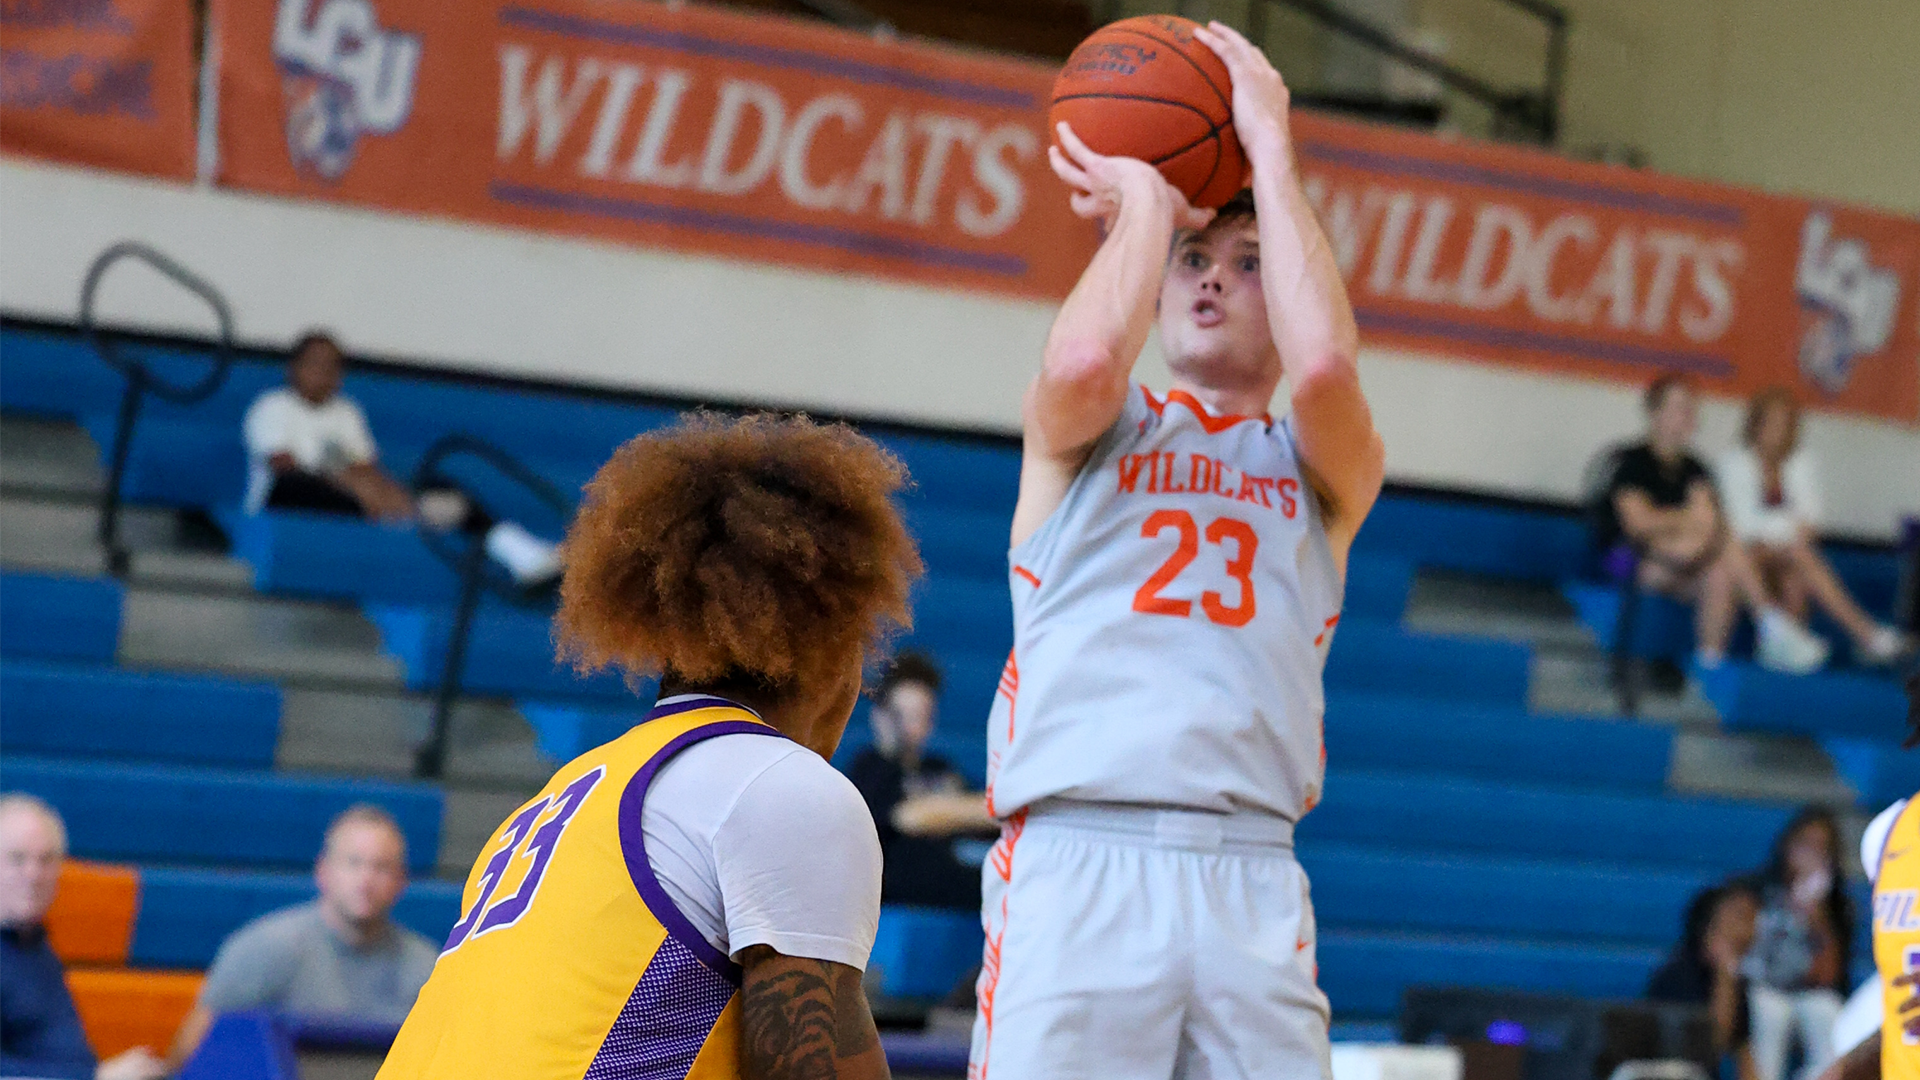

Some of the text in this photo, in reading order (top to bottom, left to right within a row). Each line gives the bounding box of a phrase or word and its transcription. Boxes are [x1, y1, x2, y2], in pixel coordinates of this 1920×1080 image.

[271, 0, 422, 136] LCU
[496, 44, 1039, 238] WILDCATS
[1117, 450, 1298, 520] WILDCATS
[1132, 508, 1259, 629] 23
[437, 764, 606, 965] 33
